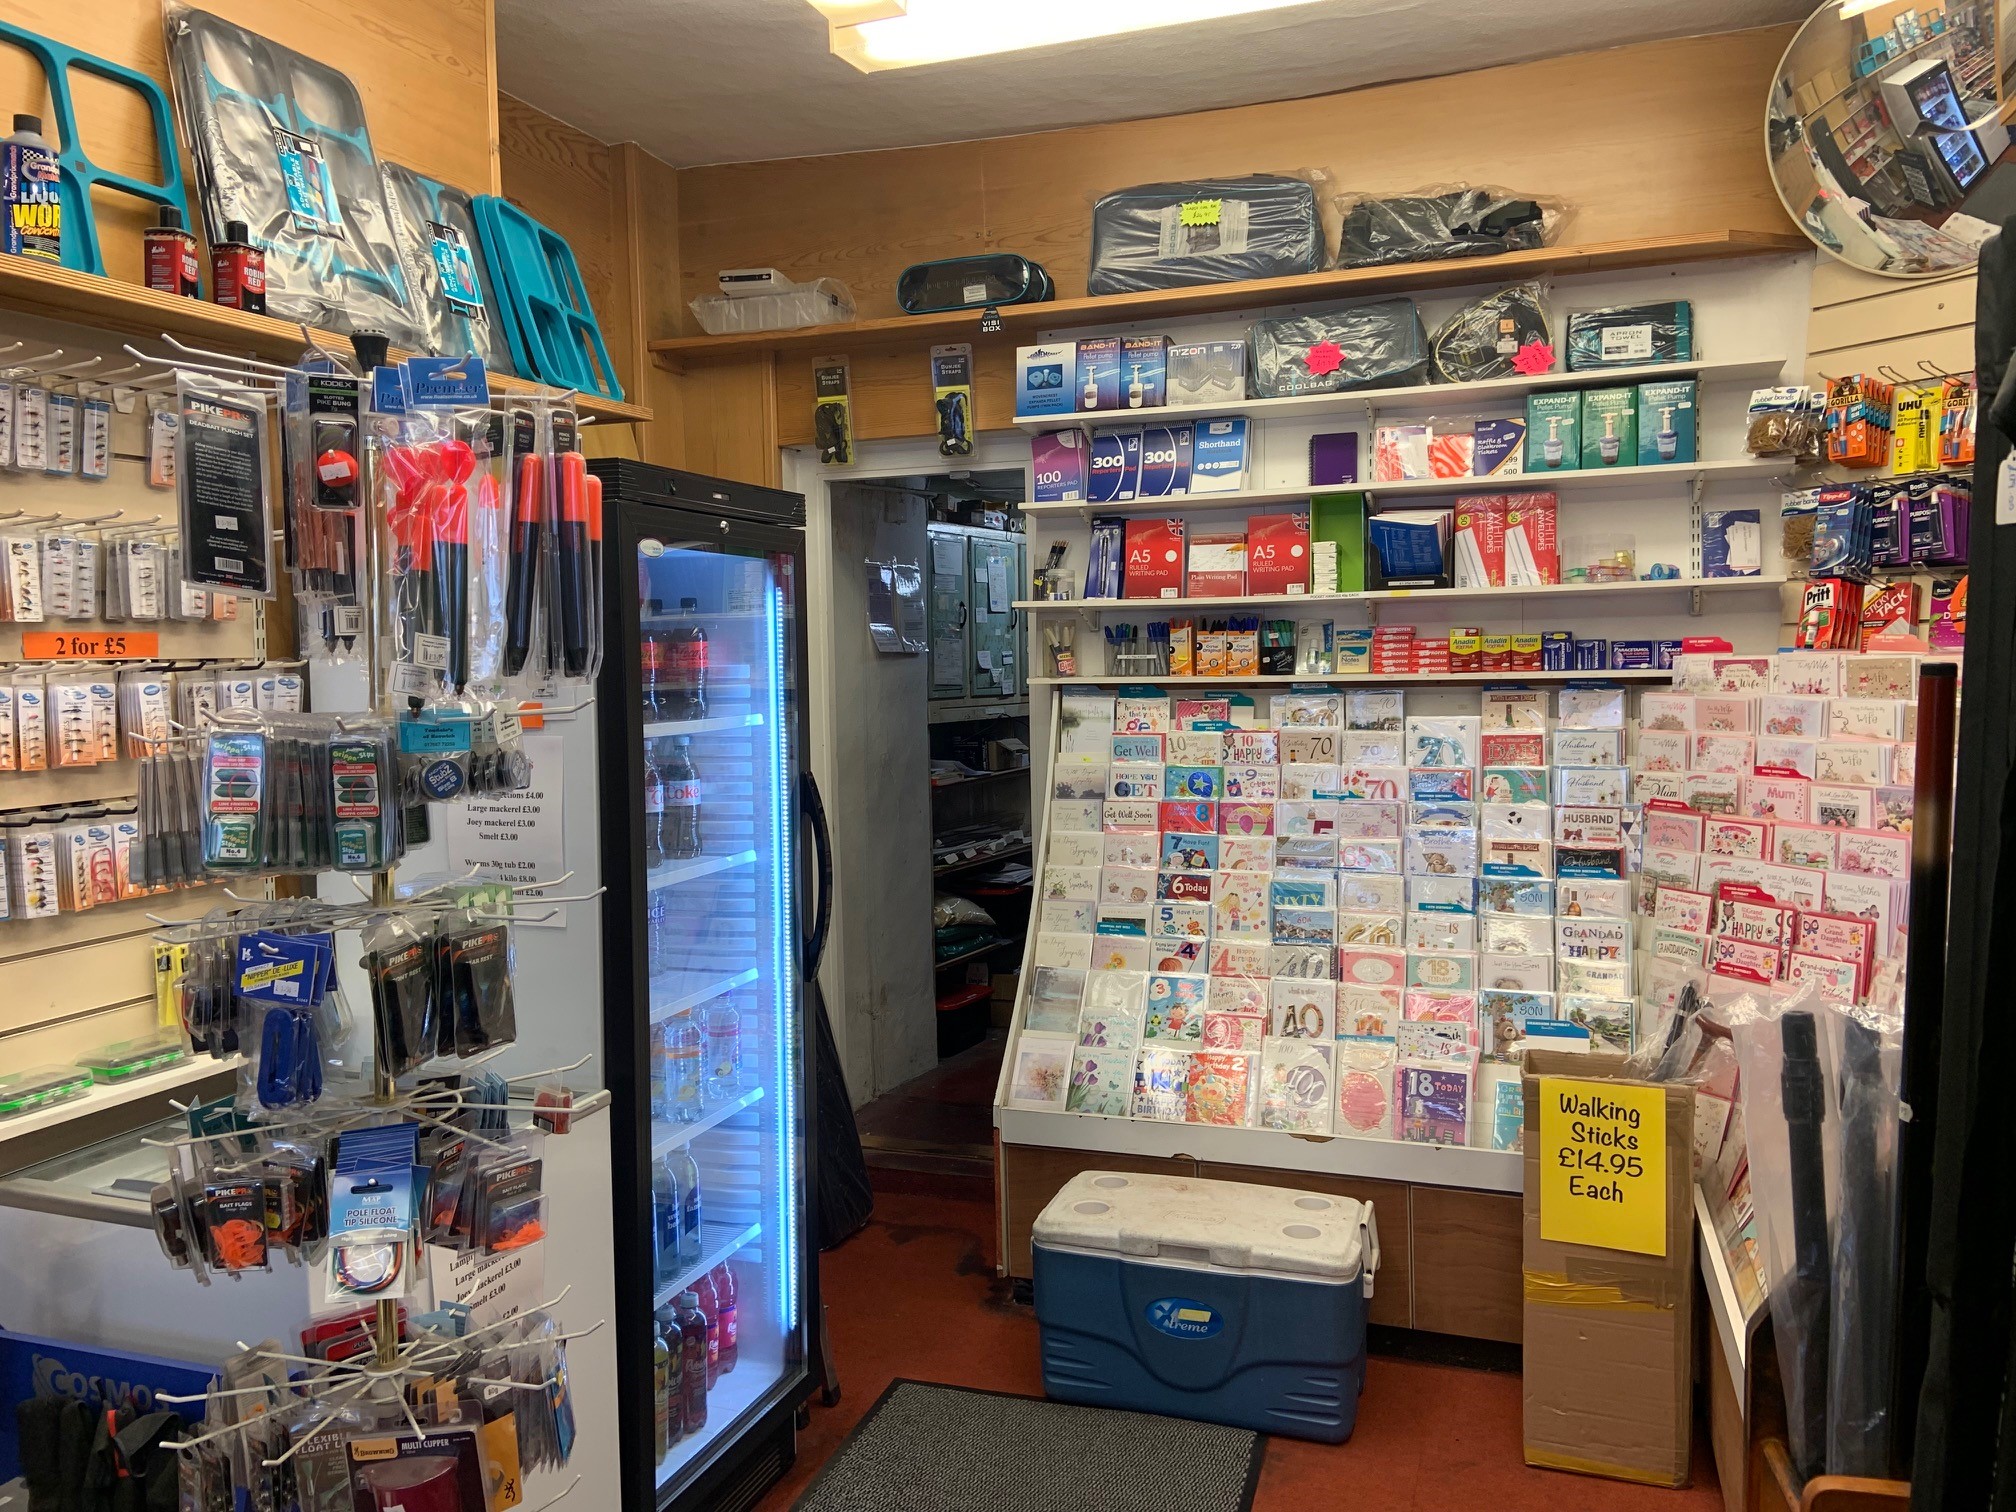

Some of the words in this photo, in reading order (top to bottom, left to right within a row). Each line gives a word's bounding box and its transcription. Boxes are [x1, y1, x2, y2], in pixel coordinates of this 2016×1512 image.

[1080, 342, 1117, 350] BAND-IT
[1125, 340, 1162, 348] BAND-IT
[320, 379, 352, 388] KODEX
[1278, 380, 1333, 392] COOLBAG
[1588, 393, 1632, 401] EXPAND-IT
[1645, 387, 1690, 396] EXPAND-IT
[1534, 397, 1576, 405] EXPAND-IT
[1754, 396, 1775, 404] rubber
[1777, 394, 1794, 402] bands
[1831, 395, 1860, 406] GORILLA
[1898, 400, 1922, 411] UHU
[189, 419, 220, 431] DEADBAIT
[221, 426, 243, 437] PUNCH
[243, 431, 254, 439] SET
[1199, 439, 1241, 449] Shorthand
[1093, 455, 1123, 469] 300
[1144, 450, 1175, 464] 300
[1037, 470, 1061, 485] 100
[1037, 481, 1065, 490] REPORTERS
[1822, 492, 1848, 500] Tipp-Ex
[1914, 502, 1928, 510] ALL
[1486, 512, 1494, 554] ENVELOPES
[1493, 512, 1504, 552] WHITE
[1537, 509, 1545, 551] ENVELOPES
[1544, 509, 1555, 550] WHITE
[1130, 550, 1150, 563] A5
[1253, 545, 1276, 559] A5
[1807, 588, 1831, 604] Pritt
[1864, 591, 1890, 617] STICKY
[1877, 589, 1908, 617] TACK
[55, 638, 65, 655] 2
[70, 637, 99, 655] for
[104, 637, 126, 655] £5
[1341, 656, 1360, 664] Notes
[1114, 746, 1132, 757] Get
[1134, 745, 1159, 756] Well
[1310, 737, 1333, 760] 70
[1488, 743, 1539, 761] DAD
[1140, 773, 1158, 781] YOU
[1245, 769, 1257, 781] 9
[667, 783, 700, 800] Coke
[1114, 781, 1158, 798] GET
[1767, 787, 1795, 800] Mum
[467, 804, 488, 813] Large
[489, 805, 521, 813] mackerel
[1104, 810, 1118, 819] Get
[1135, 810, 1152, 819] Soon
[467, 818, 483, 828] Joey
[484, 819, 516, 827] mackerel
[1564, 813, 1614, 824] HUSBAND
[479, 832, 499, 840] Smelt
[500, 833, 519, 841] £3.00
[1171, 836, 1183, 849] 7
[491, 861, 503, 869] 30g
[518, 861, 536, 869] £2.00
[504, 874, 518, 882] kilo
[519, 875, 536, 883] £8.00
[1172, 878, 1183, 893] 6
[1184, 881, 1208, 894] Today
[1519, 893, 1543, 903] SON
[1160, 907, 1174, 921] 5
[1563, 926, 1623, 940] GRANDAD
[1732, 921, 1764, 939] HAPPY
[1568, 944, 1620, 958] HAPPY
[1427, 959, 1450, 976] 18
[1427, 975, 1451, 983] TODAY
[1586, 971, 1625, 980] GRANDAD
[1155, 983, 1165, 994] 3
[1519, 1005, 1543, 1016] SON
[1231, 1057, 1245, 1071] 2
[1410, 1073, 1434, 1097] 18
[1434, 1081, 1464, 1093] TODAY
[1560, 1093, 1640, 1129] Walking
[1571, 1121, 1639, 1150] Sticks
[1558, 1147, 1643, 1178] £14.95
[1569, 1175, 1623, 1203] Each
[347, 1209, 369, 1217] POLE
[371, 1207, 395, 1216] FLOAT
[344, 1218, 357, 1227] TIP
[359, 1216, 398, 1225] SILICONE
[401, 1441, 422, 1451] MULTI
[423, 1438, 450, 1449] CUPPER
